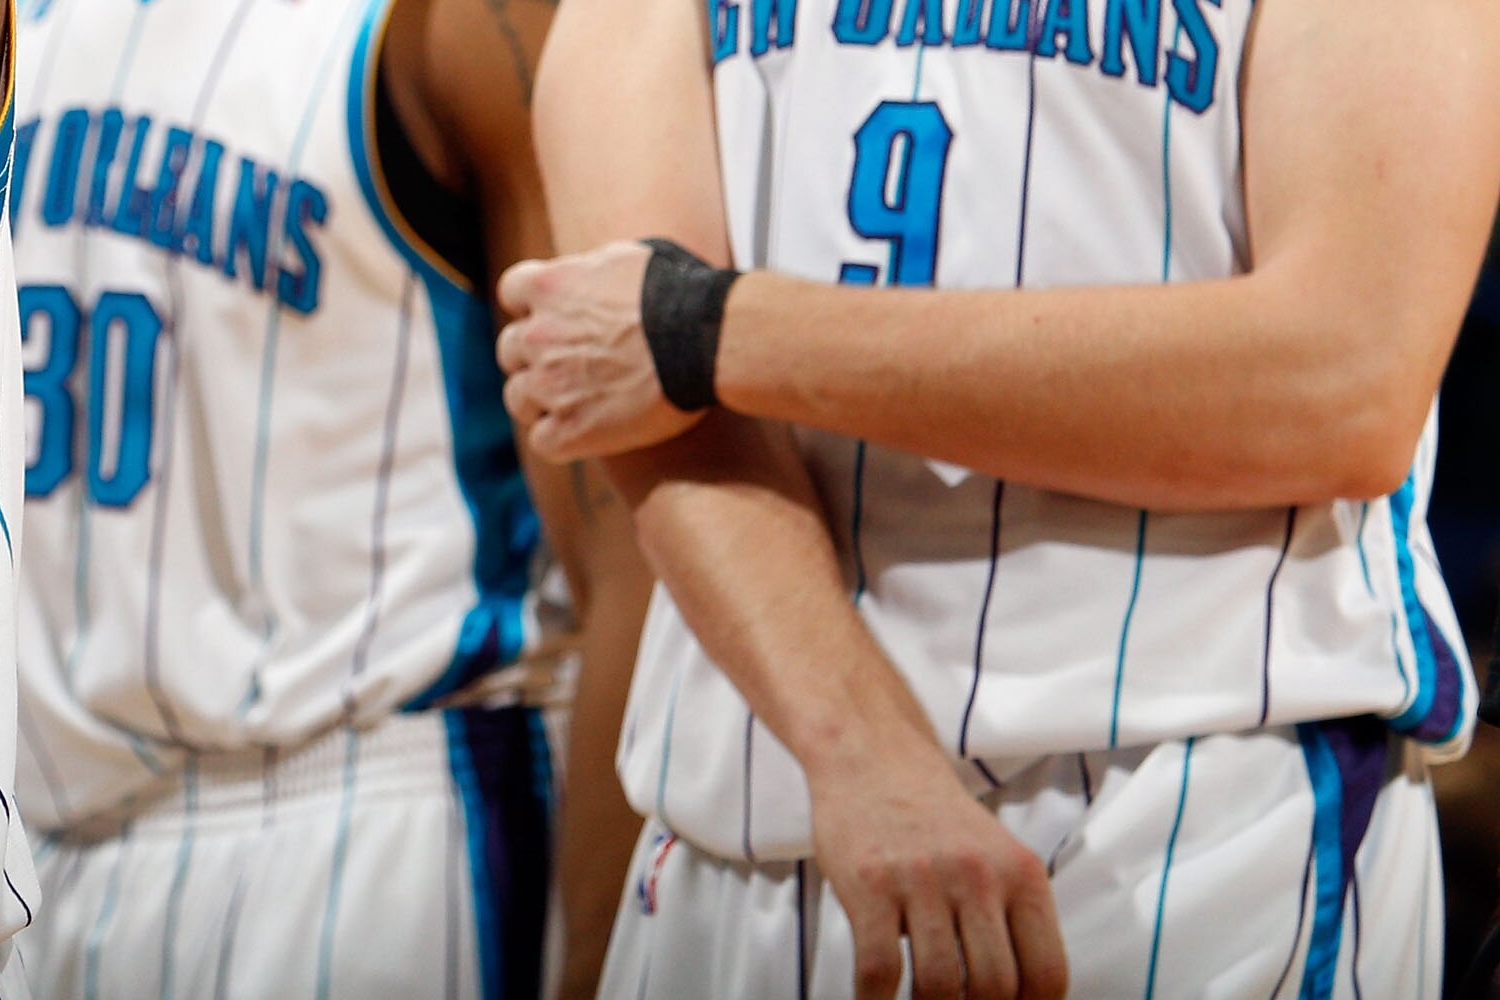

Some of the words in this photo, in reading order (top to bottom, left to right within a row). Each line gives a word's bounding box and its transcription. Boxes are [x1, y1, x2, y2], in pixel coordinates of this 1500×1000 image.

[41, 107, 330, 316] ORLEANS
[837, 99, 954, 289] 9
[19, 283, 165, 511] 30
